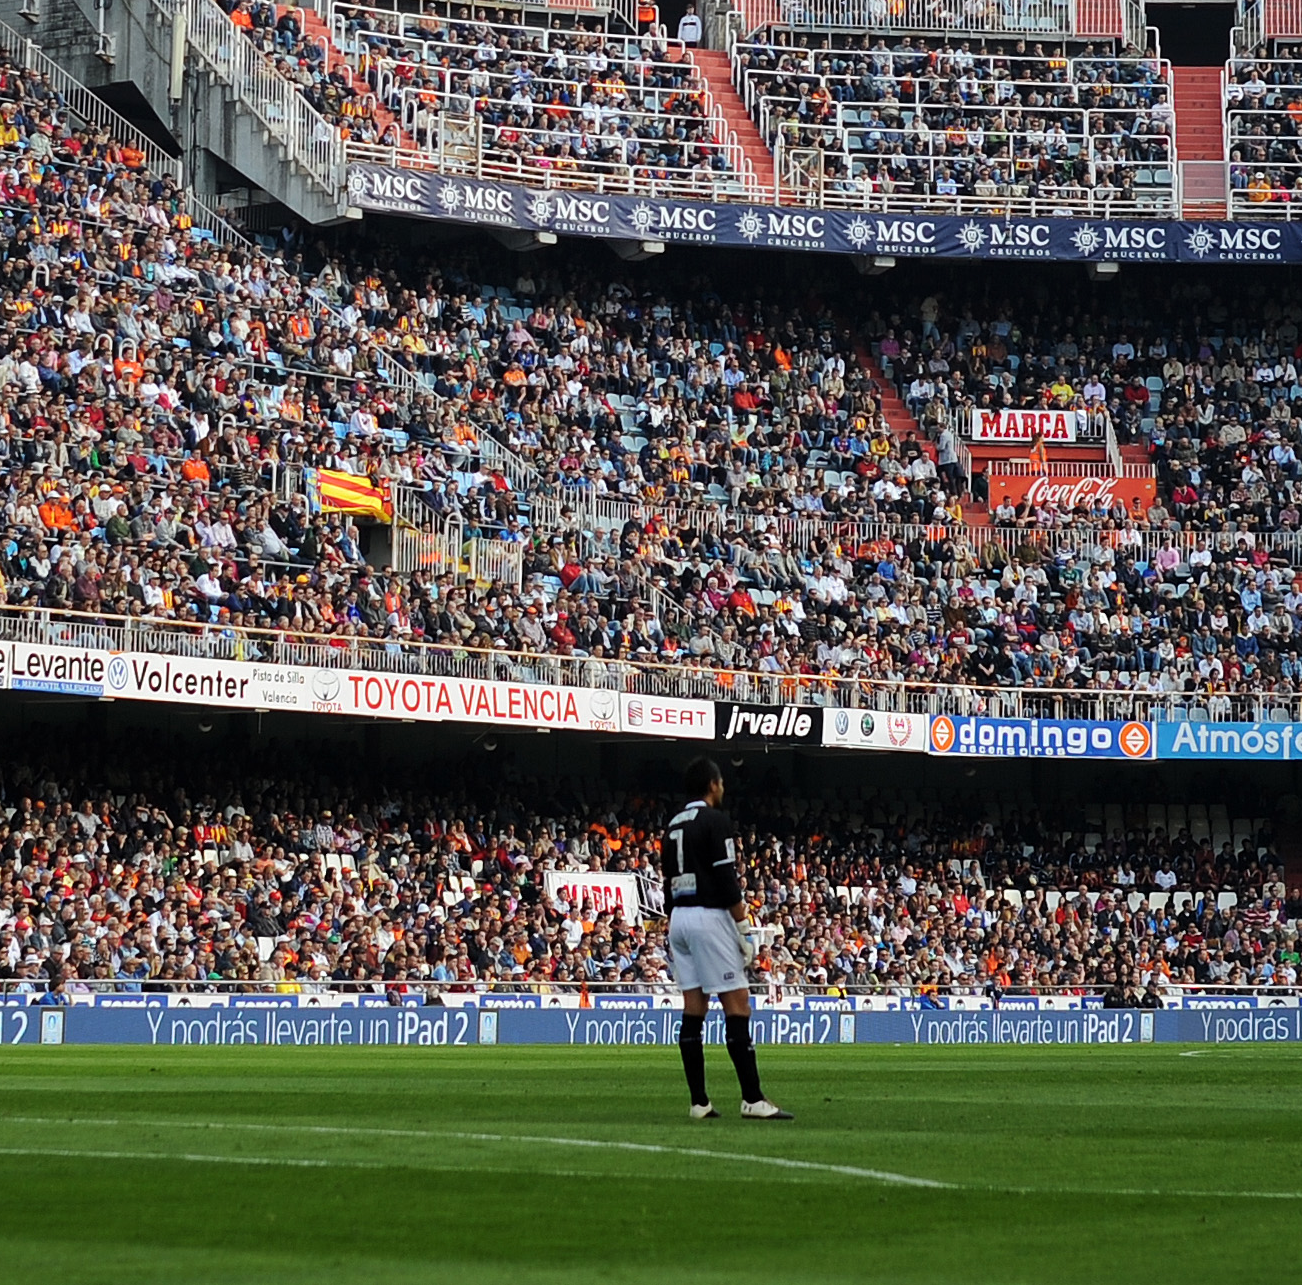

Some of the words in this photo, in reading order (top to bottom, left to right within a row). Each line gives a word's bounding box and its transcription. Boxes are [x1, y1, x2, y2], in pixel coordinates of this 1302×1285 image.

[373, 173, 421, 200] MSC
[555, 197, 609, 223] MSC
[658, 205, 716, 230] MSC
[659, 229, 716, 241] CRUCEROS
[767, 212, 825, 237] MSC
[876, 220, 935, 244] MSC
[876, 244, 936, 254] CRUCEROS
[1104, 227, 1166, 249] MSC
[1104, 251, 1166, 259] CRUCEROS
[980, 413, 1069, 438] MARCA
[11, 643, 104, 682] Levante
[133, 659, 249, 699] Volcenter
[253, 668, 272, 683] Pista
[274, 671, 285, 683] de
[262, 690, 298, 705] Valencia
[312, 700, 342, 713] TOYOTA
[349, 675, 453, 715] TOYOTA
[459, 682, 580, 723] VALENCIA
[650, 707, 707, 727] SEAT
[725, 705, 812, 739] jrvalle
[959, 717, 1112, 755] domingo
[12, 1011, 28, 1045] 2
[1200, 1012, 1212, 1042] Y
